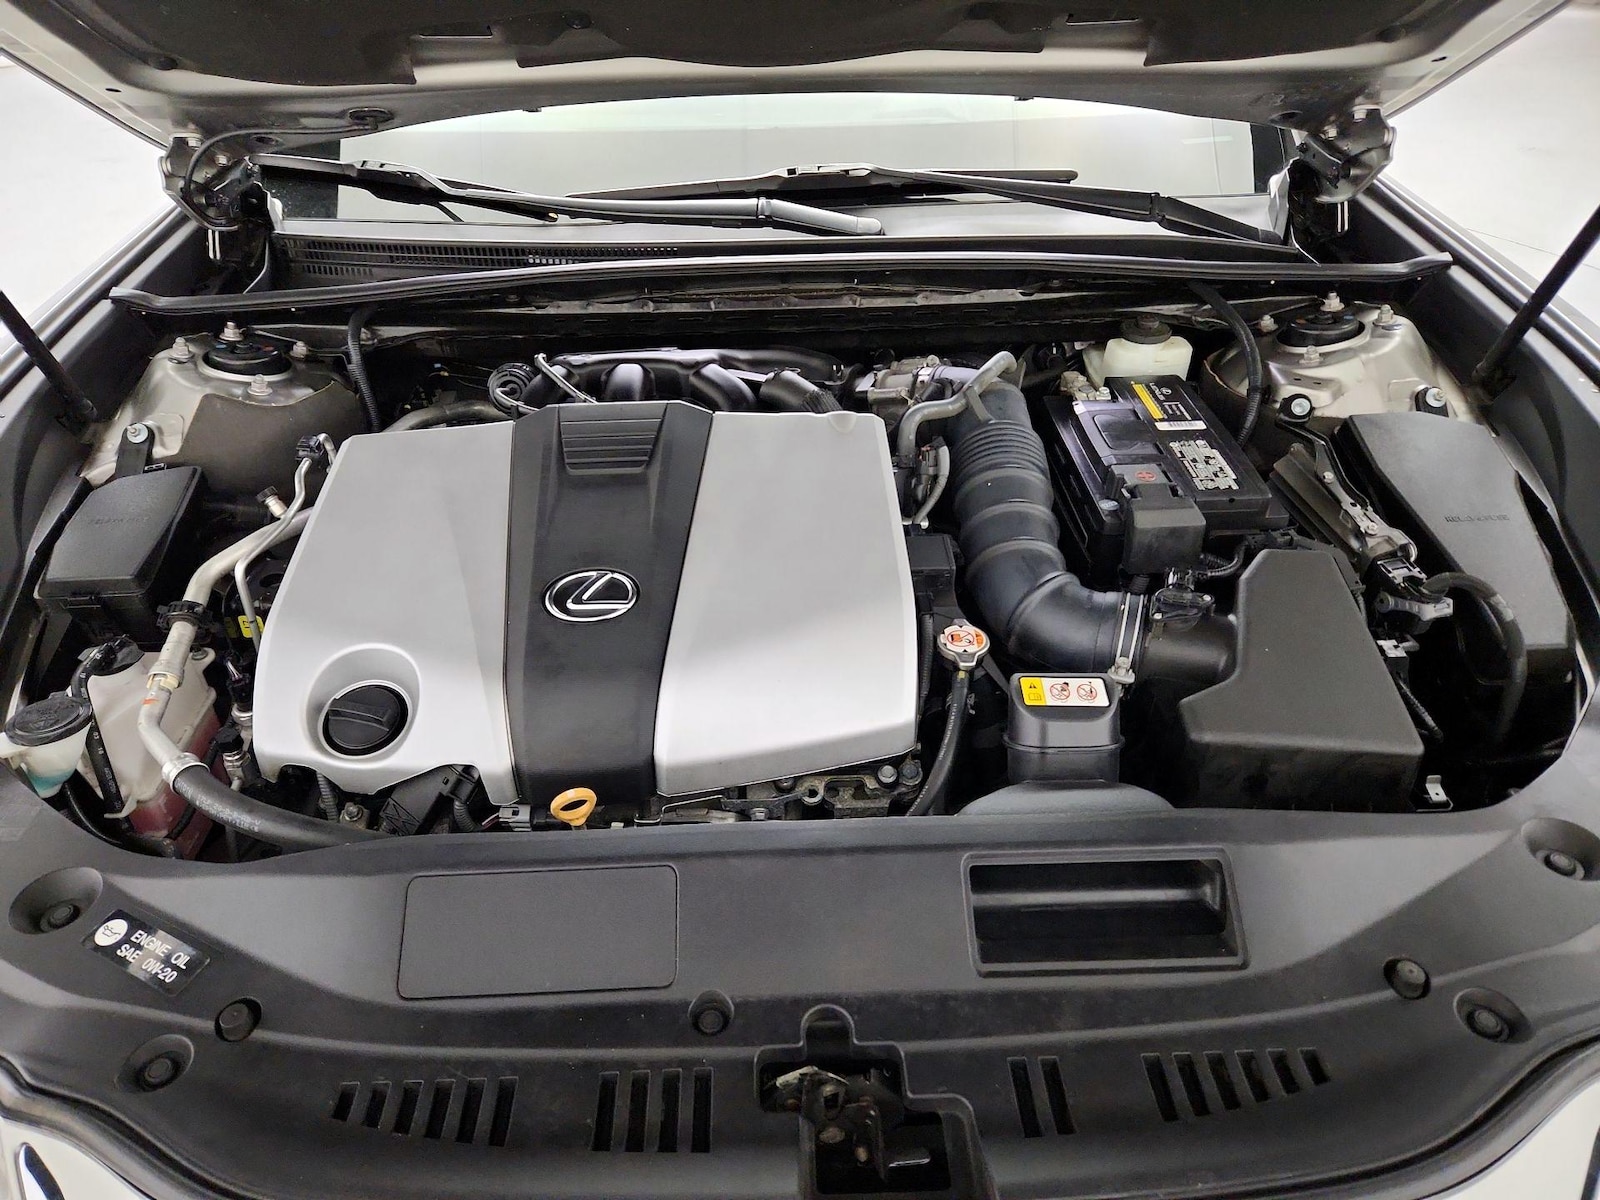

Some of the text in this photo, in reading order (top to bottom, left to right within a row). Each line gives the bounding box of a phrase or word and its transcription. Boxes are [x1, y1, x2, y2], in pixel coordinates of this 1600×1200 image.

[116, 943, 178, 983] SAE 0W-20
[130, 929, 191, 970] ENGINE OIL
